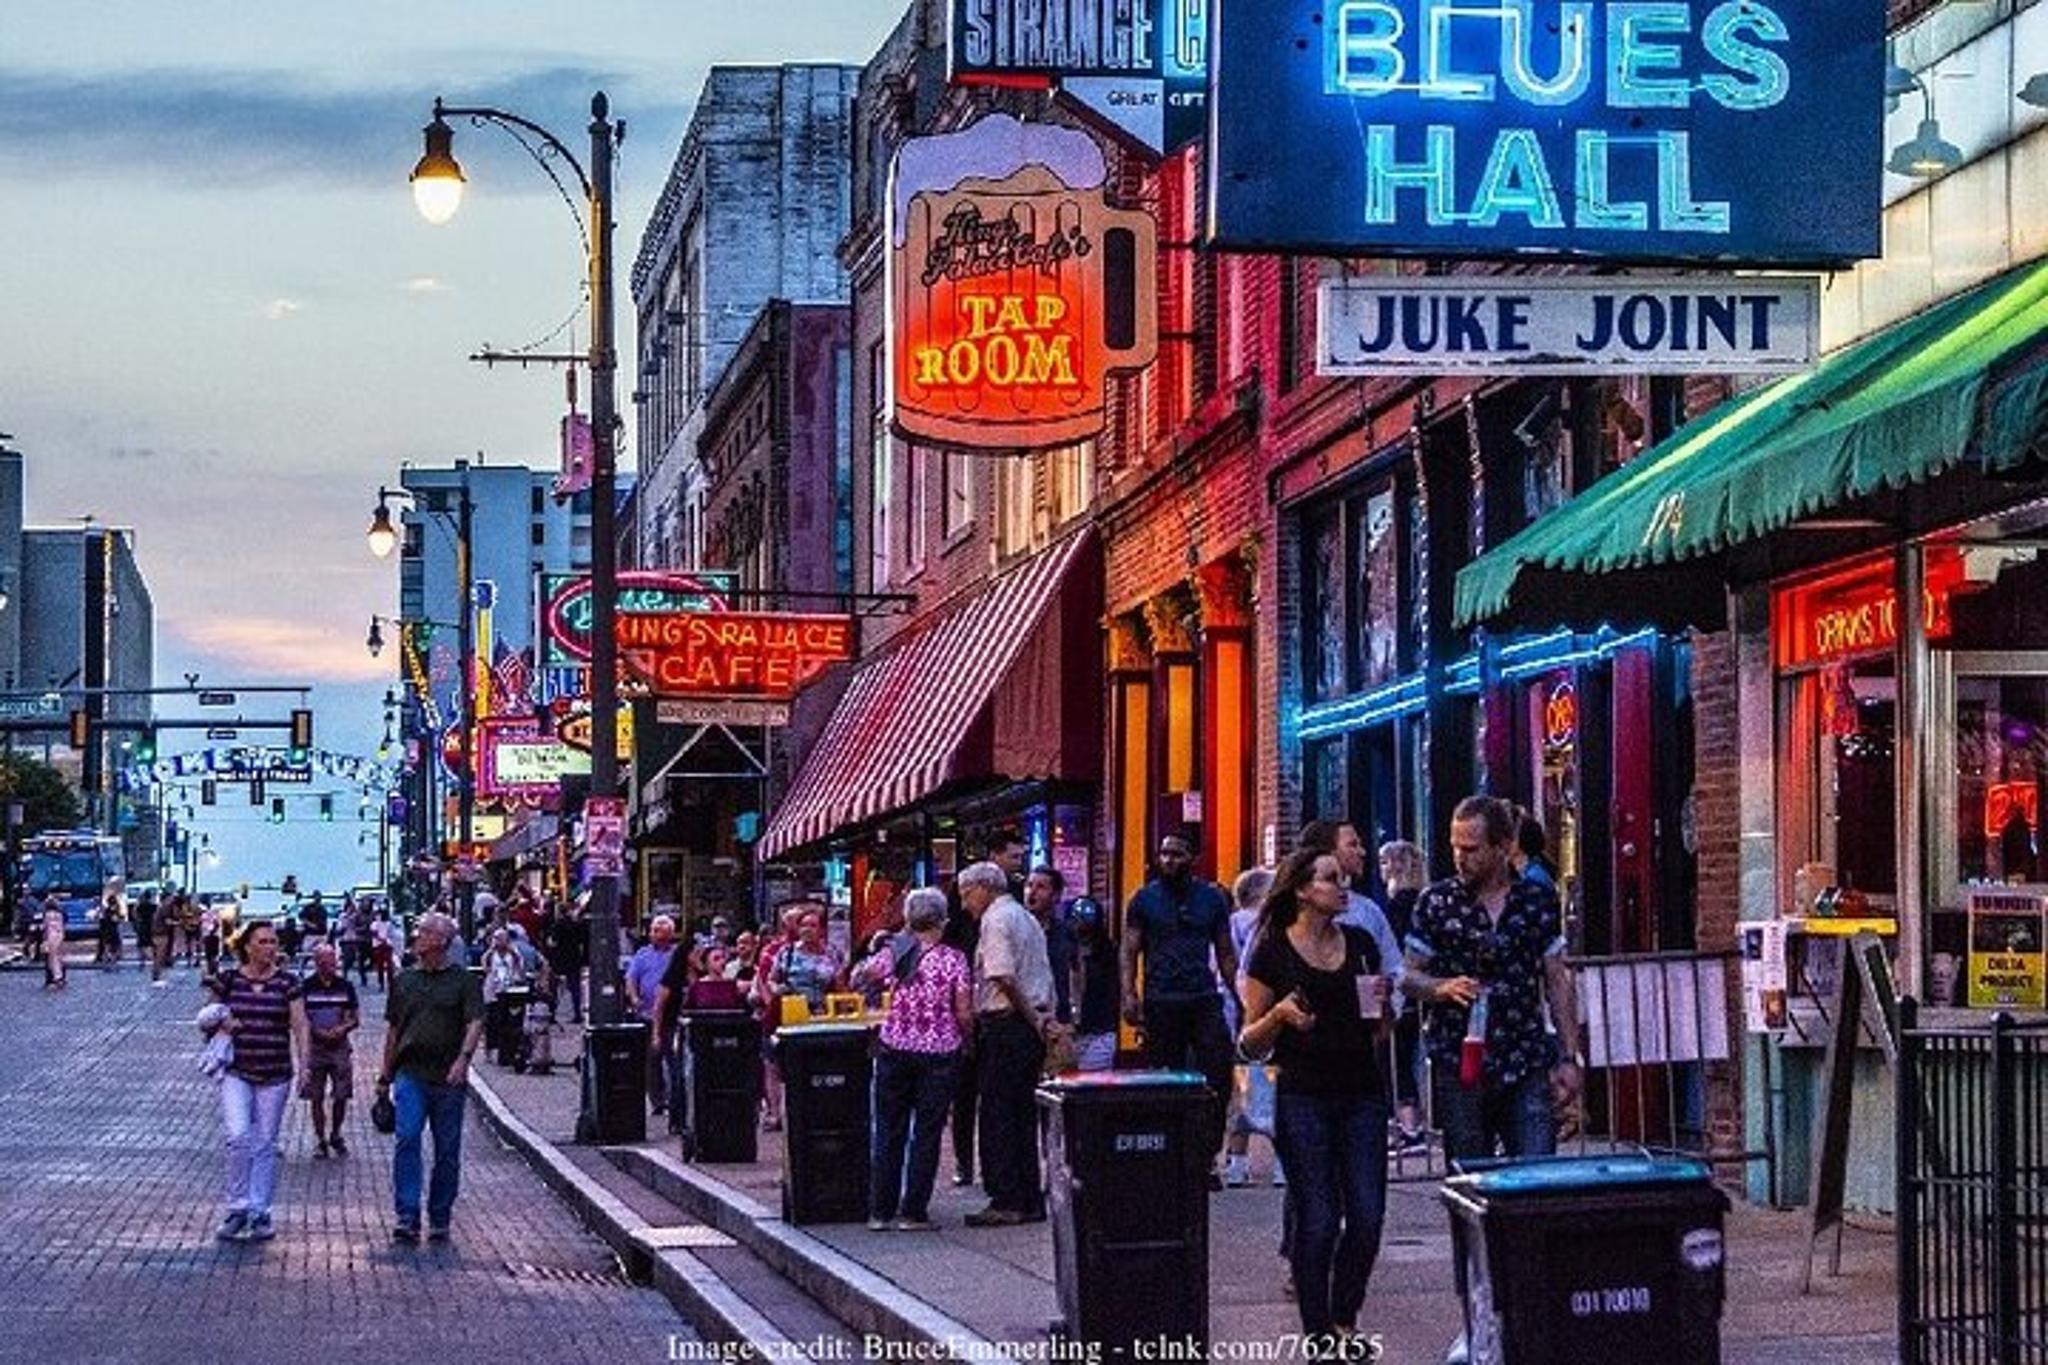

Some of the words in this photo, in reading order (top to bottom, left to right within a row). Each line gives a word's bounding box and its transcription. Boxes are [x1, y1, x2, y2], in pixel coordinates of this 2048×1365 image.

[966, 0, 1153, 69] STRANGE
[1325, 0, 1789, 109] BLUES
[1364, 124, 1730, 233] HALL
[961, 294, 1068, 338] TAP
[1359, 295, 1531, 352] JUKE
[1576, 295, 1780, 351] JOINT
[916, 333, 1079, 385] ROOM
[660, 656, 792, 687] CAFE
